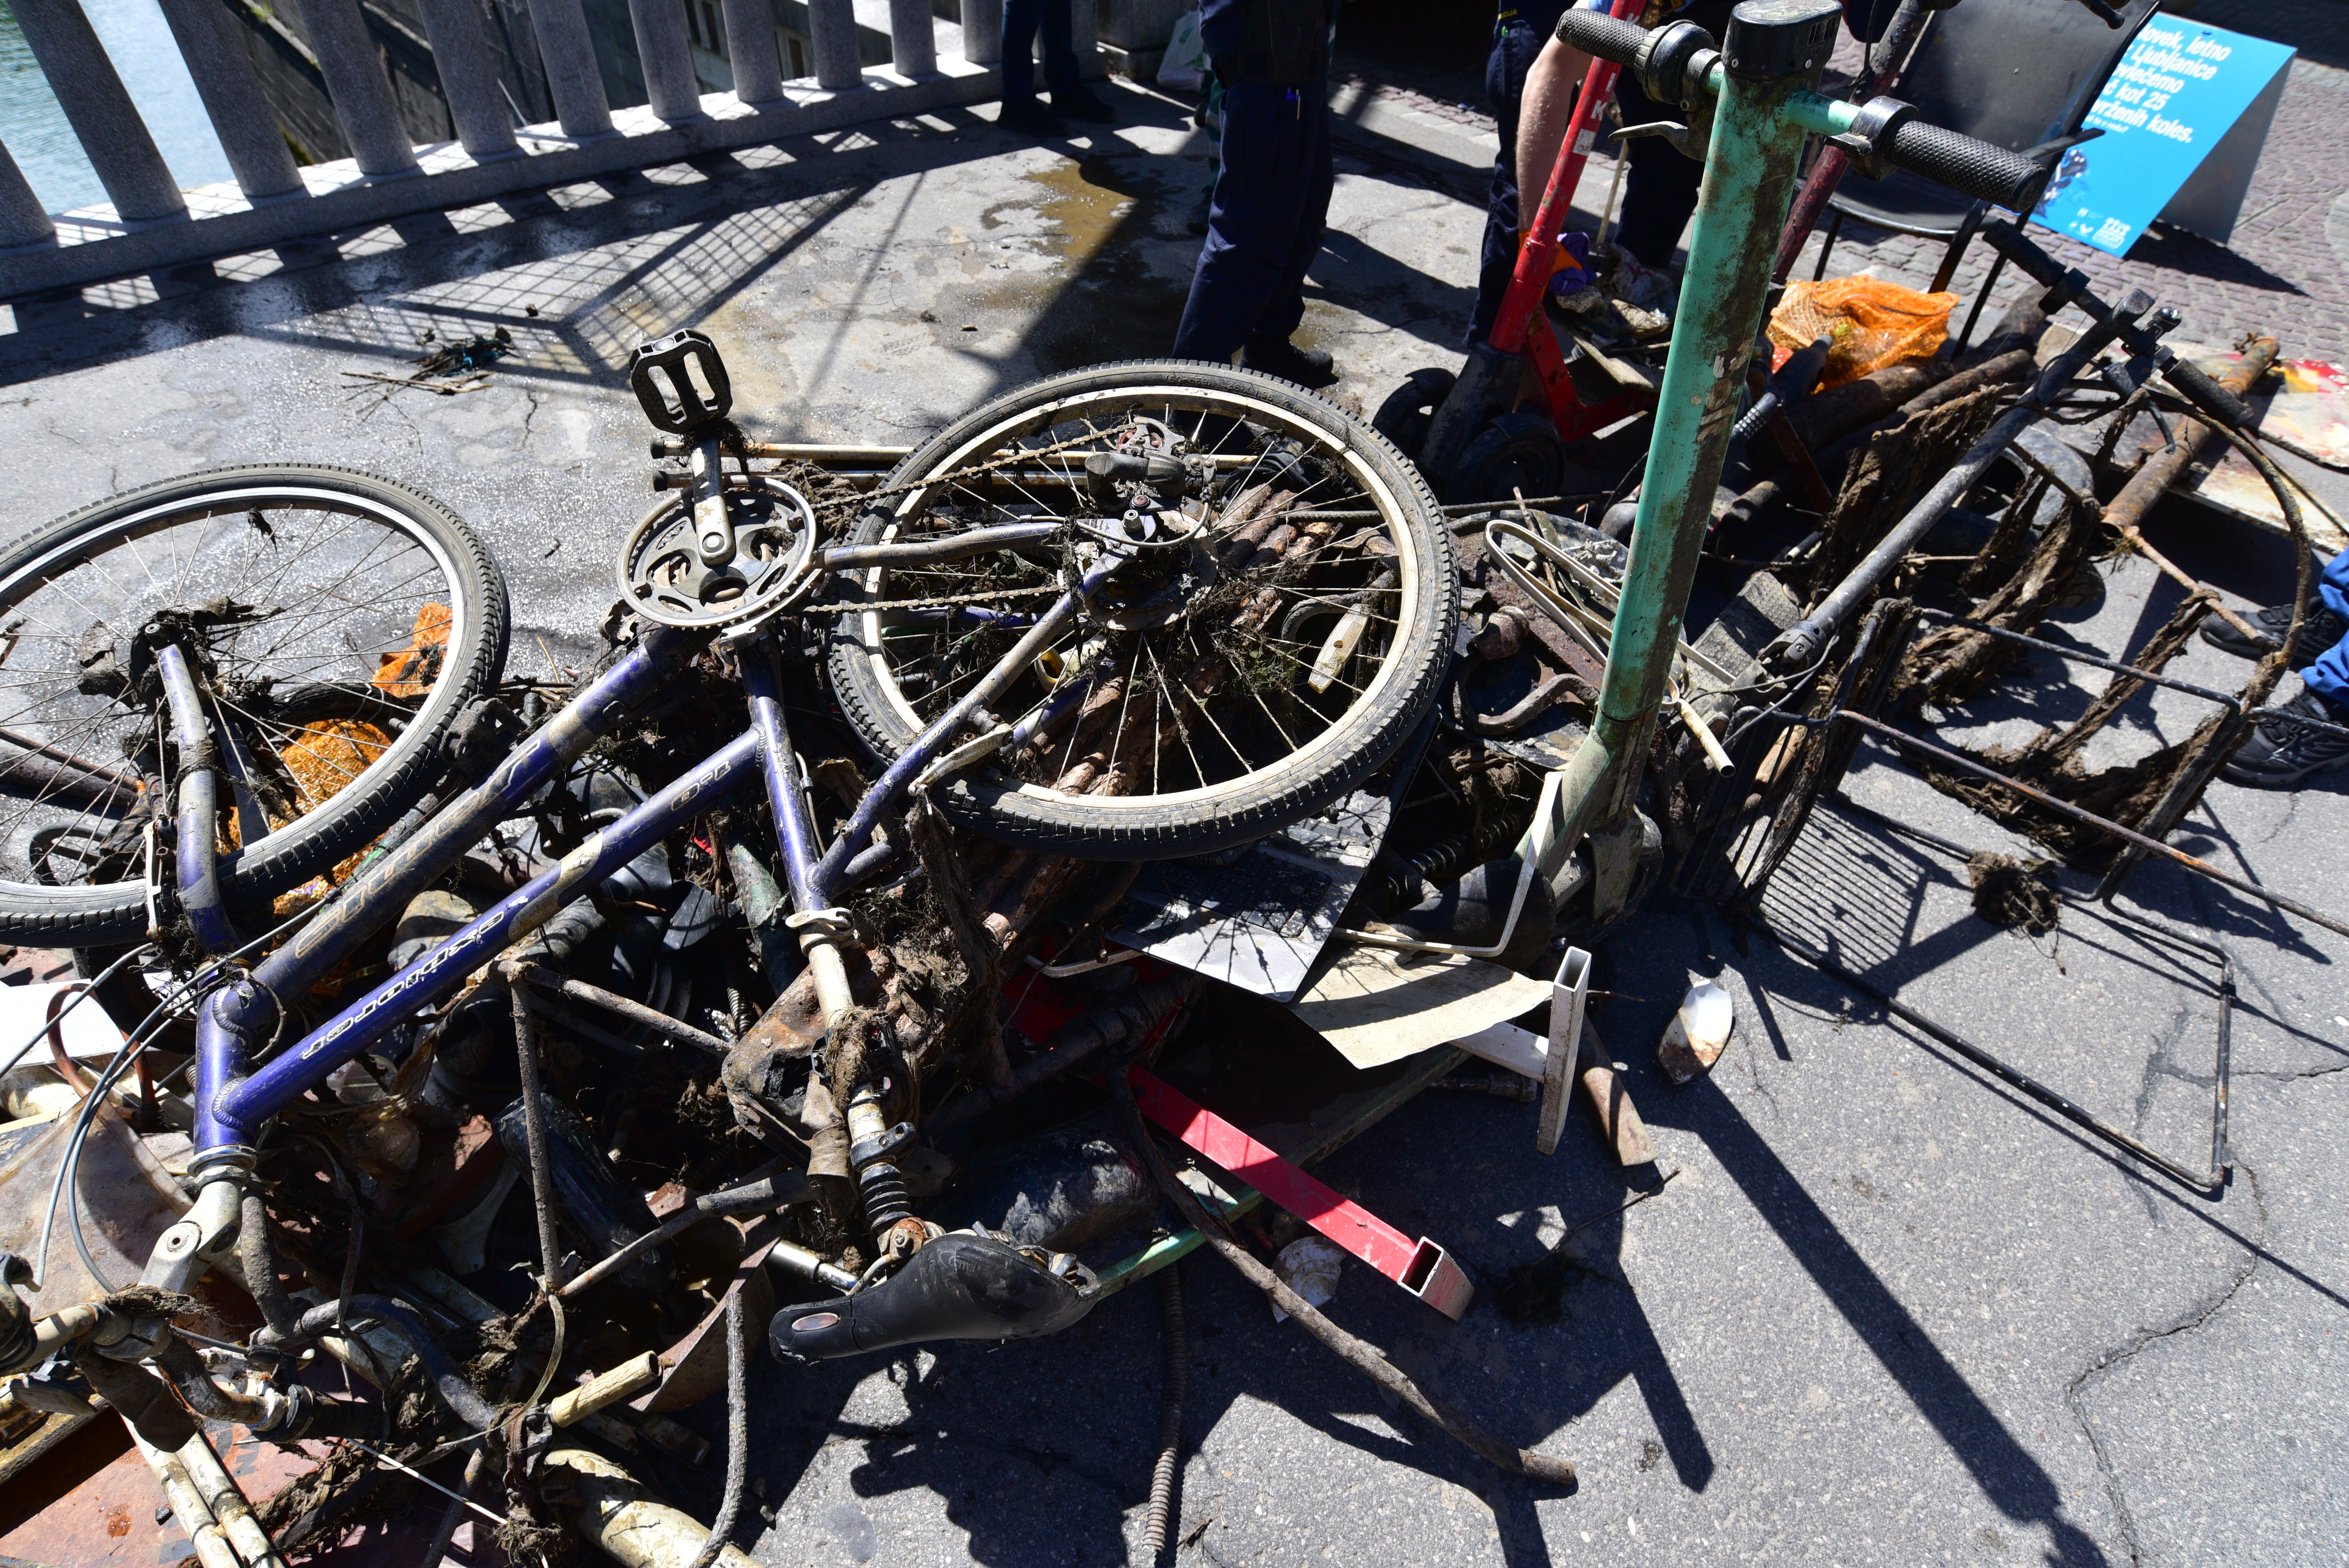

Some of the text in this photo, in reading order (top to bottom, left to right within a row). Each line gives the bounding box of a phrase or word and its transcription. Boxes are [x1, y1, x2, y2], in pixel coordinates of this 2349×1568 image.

[2137, 23, 2184, 51] lovek,
[2185, 36, 2232, 61] letno
[2112, 62, 2185, 93] ovlečemo
[2131, 43, 2218, 80] Ljubljanice
[2115, 82, 2147, 104] kot
[2142, 91, 2171, 111] 25
[2091, 99, 2194, 143] vrženih koles.
[302, 911, 505, 1059] explorer
